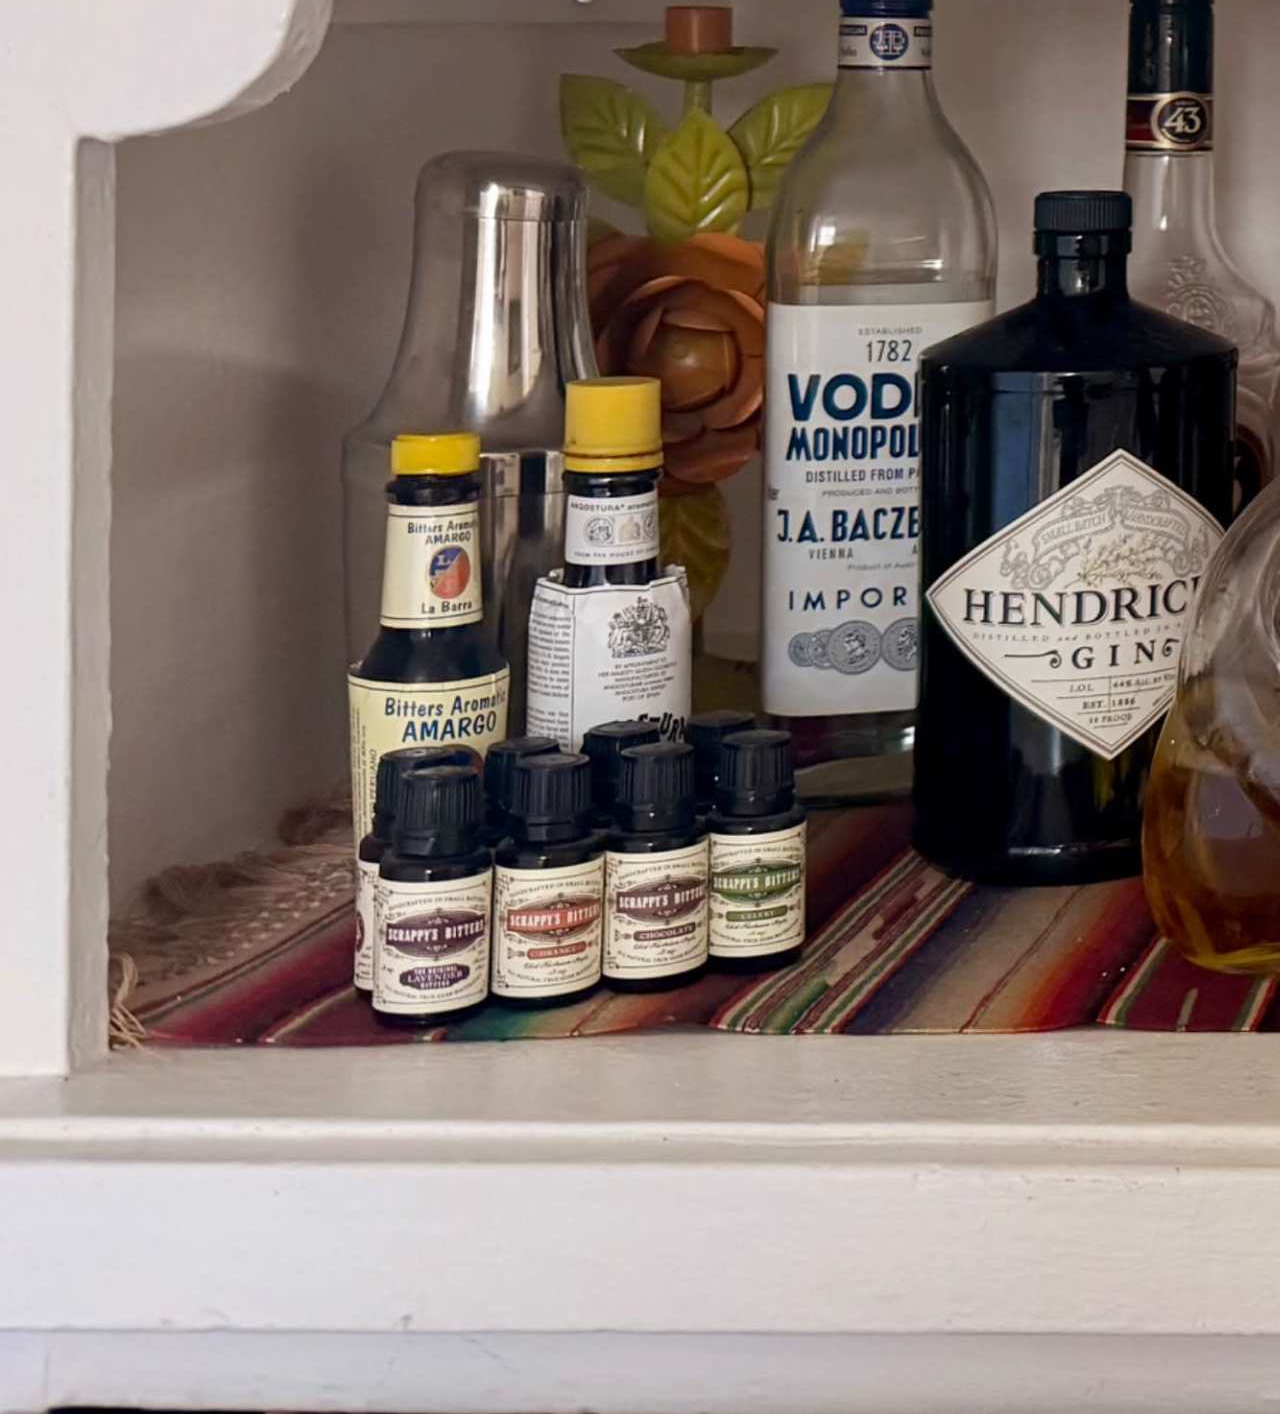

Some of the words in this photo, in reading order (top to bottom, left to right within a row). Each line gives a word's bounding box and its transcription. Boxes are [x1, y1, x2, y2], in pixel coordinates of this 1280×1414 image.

[1164, 107, 1202, 134] 43
[866, 339, 912, 363] 1782
[805, 470, 866, 483] DISTILLED
[870, 468, 904, 481] FROM
[408, 522, 442, 534] Bitters
[425, 531, 472, 545] AMARGO
[809, 548, 854, 561] VIENNA
[421, 603, 435, 614] La
[441, 601, 472, 613] Barra
[1086, 627, 1150, 640] BOTTLED
[1071, 640, 1156, 670] GIN
[385, 697, 444, 717] Bitters
[402, 711, 497, 742] AMARGO
[388, 927, 439, 942] SCRAPPY'S
